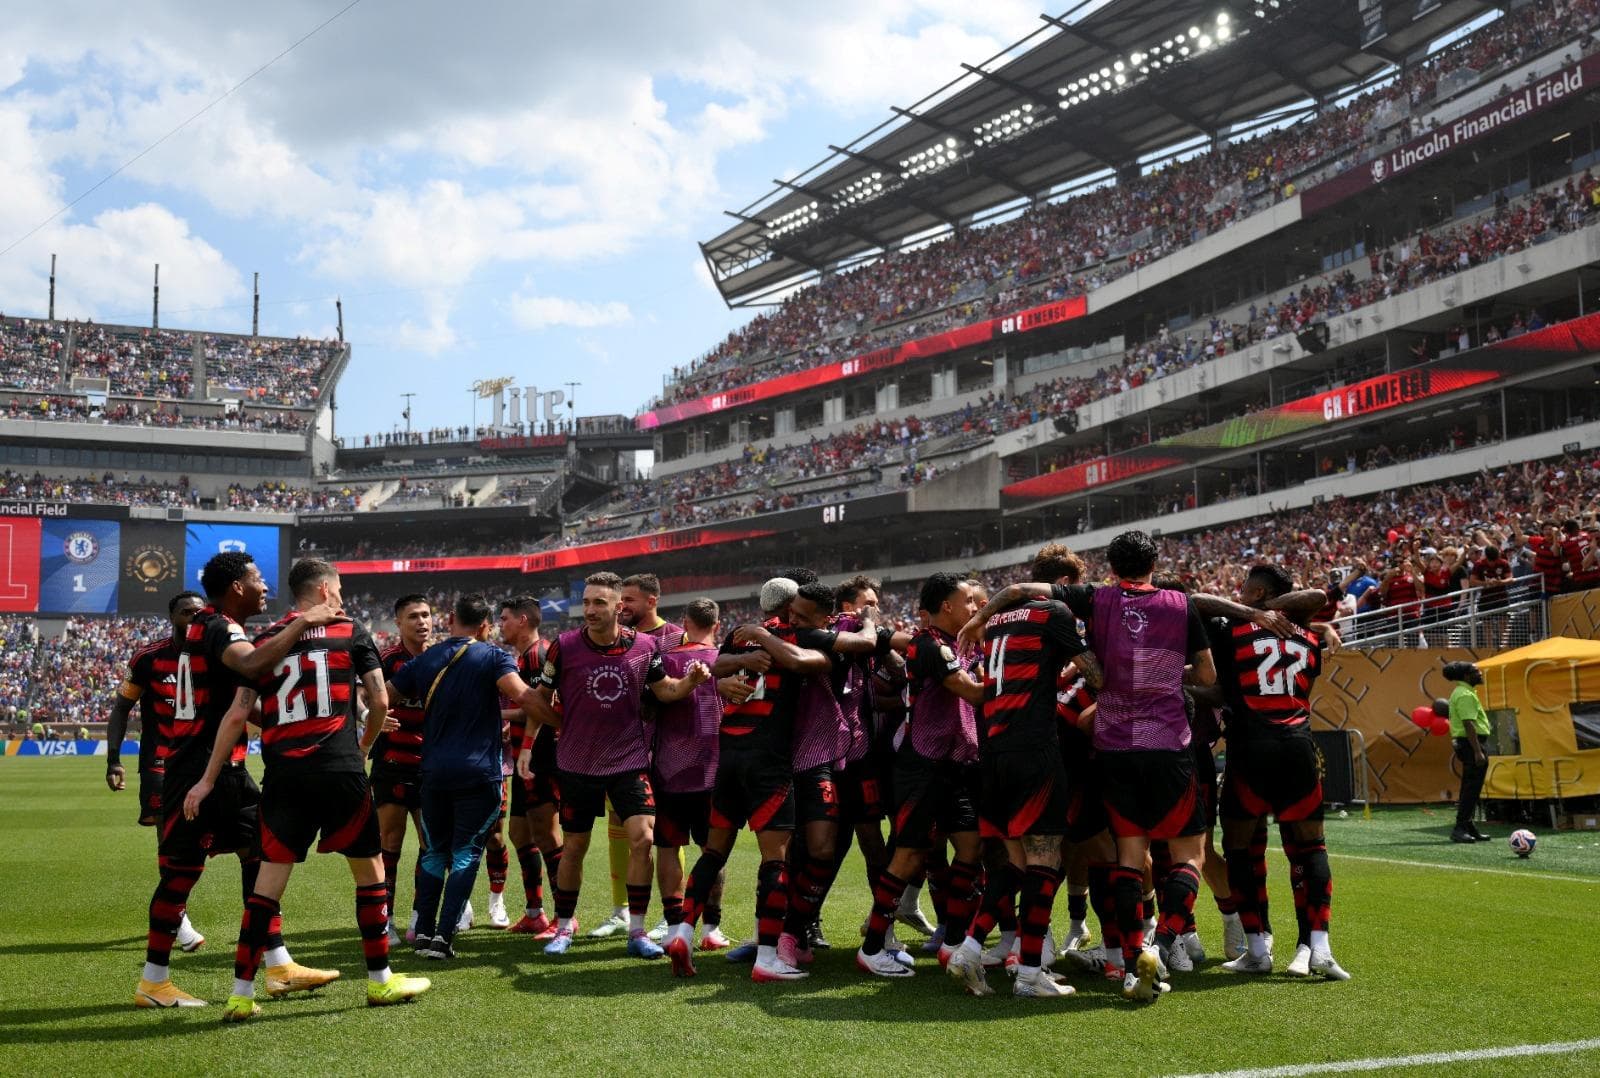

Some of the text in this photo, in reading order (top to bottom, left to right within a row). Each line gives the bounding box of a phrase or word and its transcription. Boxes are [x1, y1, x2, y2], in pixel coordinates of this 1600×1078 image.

[1392, 66, 1583, 172] Lincoln Financial Field
[0, 503, 68, 516] ncial Field
[73, 574, 87, 592] 1
[273, 649, 332, 725] 21
[988, 633, 1009, 697] 4
[1252, 636, 1311, 697] 22
[37, 741, 78, 755] VISA
